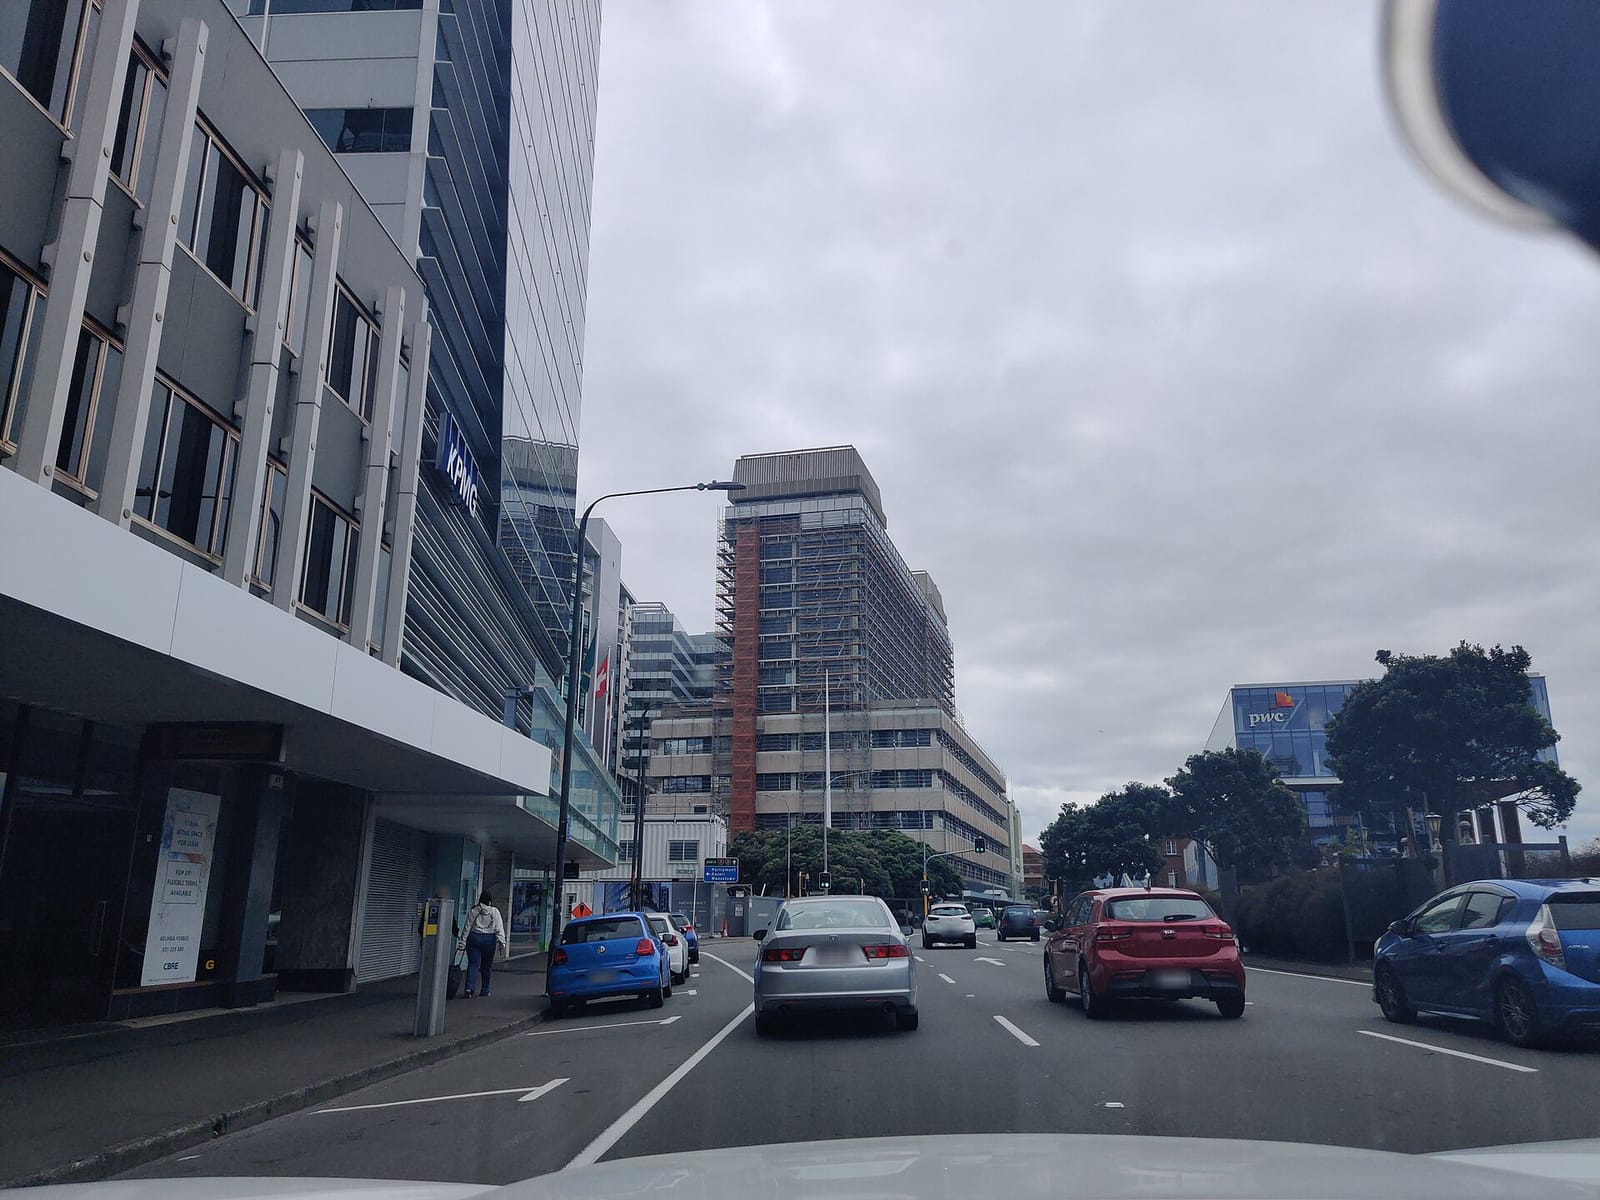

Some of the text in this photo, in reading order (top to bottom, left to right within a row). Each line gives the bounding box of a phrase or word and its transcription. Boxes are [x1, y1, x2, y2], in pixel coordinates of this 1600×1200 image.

[446, 441, 479, 519] KPMG
[1248, 712, 1285, 727] pwc
[430, 906, 438, 919] P
[163, 962, 179, 970] CBRE
[206, 960, 215, 970] G
